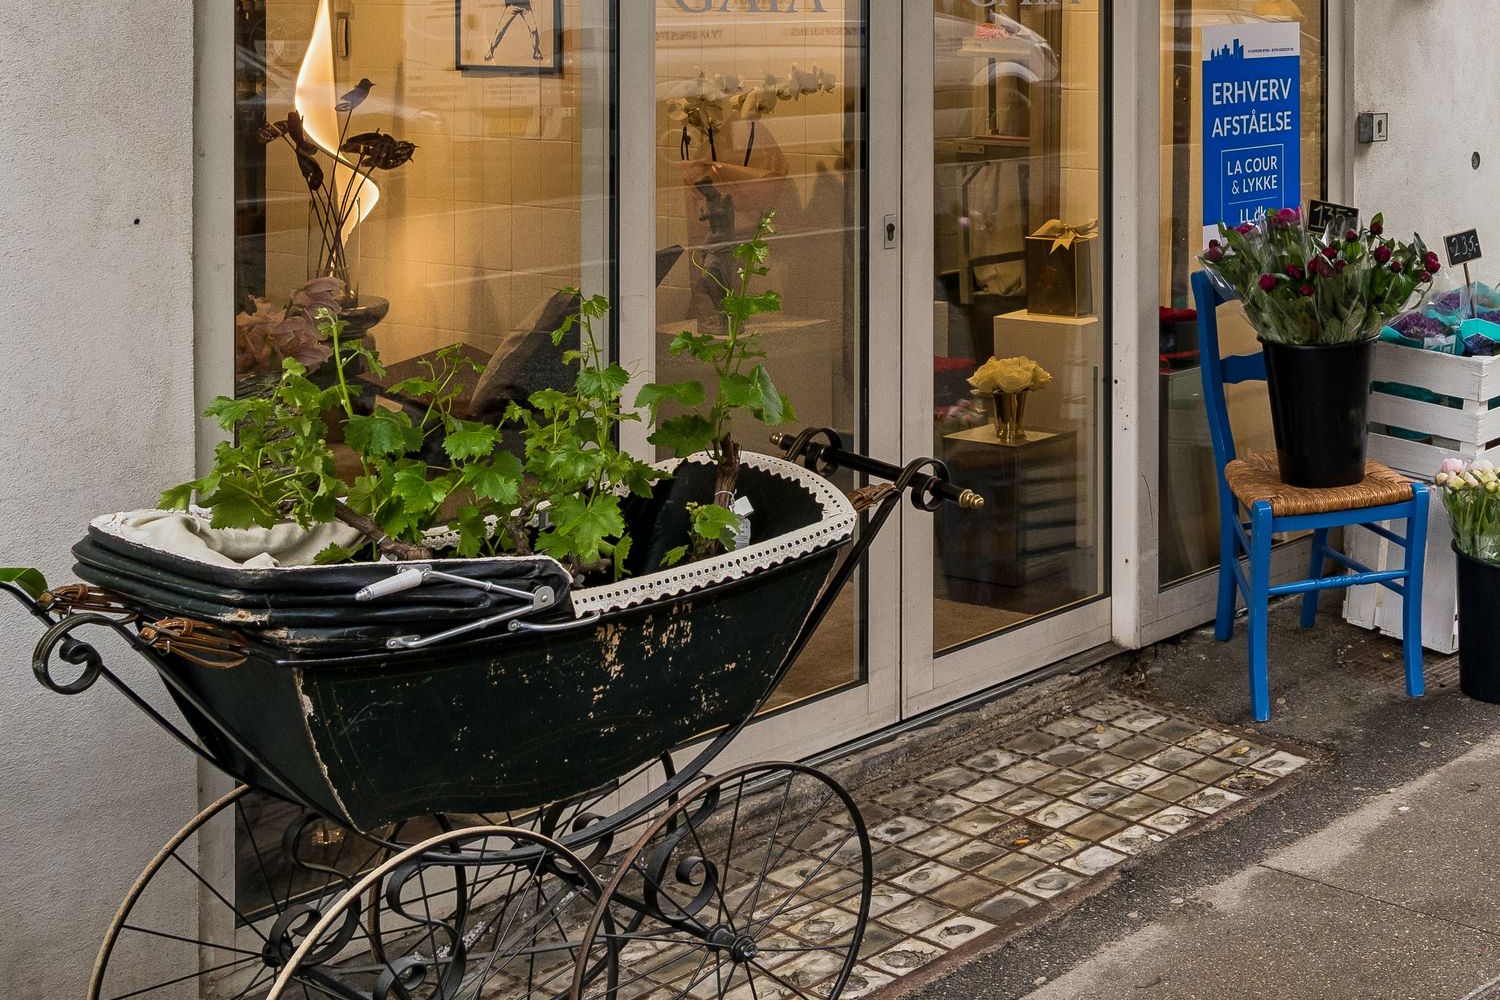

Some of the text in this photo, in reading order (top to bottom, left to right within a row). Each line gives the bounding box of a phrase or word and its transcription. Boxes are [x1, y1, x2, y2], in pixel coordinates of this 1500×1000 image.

[1212, 77, 1292, 106] ERHVERV
[1211, 108, 1292, 138] AFSTÅELSE
[1227, 155, 1278, 176] LA COUR
[1232, 174, 1278, 195] & LYKKE
